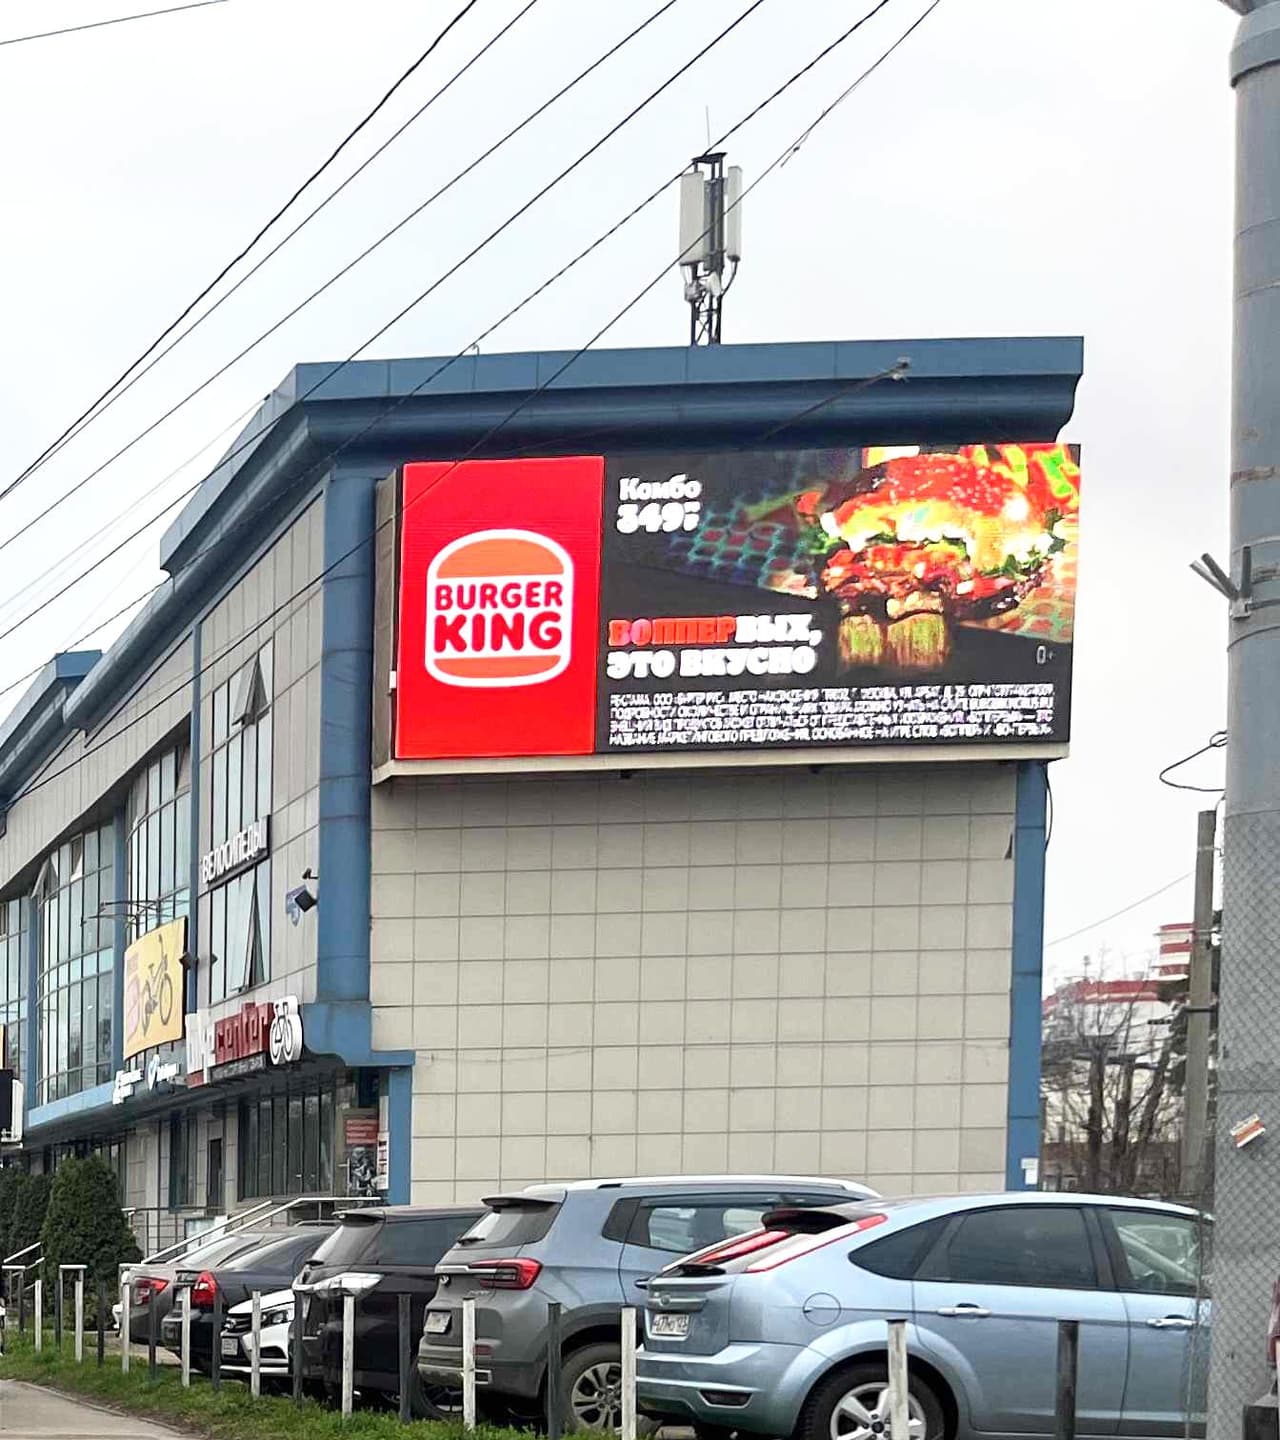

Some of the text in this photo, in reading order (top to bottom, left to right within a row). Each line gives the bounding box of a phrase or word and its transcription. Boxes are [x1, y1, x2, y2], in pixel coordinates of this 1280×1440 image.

[619, 474, 702, 500] Комбо
[435, 581, 563, 610] BURGER
[434, 611, 562, 652] KING
[606, 646, 818, 679] ЭТО ВКУСНО
[202, 816, 268, 884] ВЕЛОСИПЕДЫ
